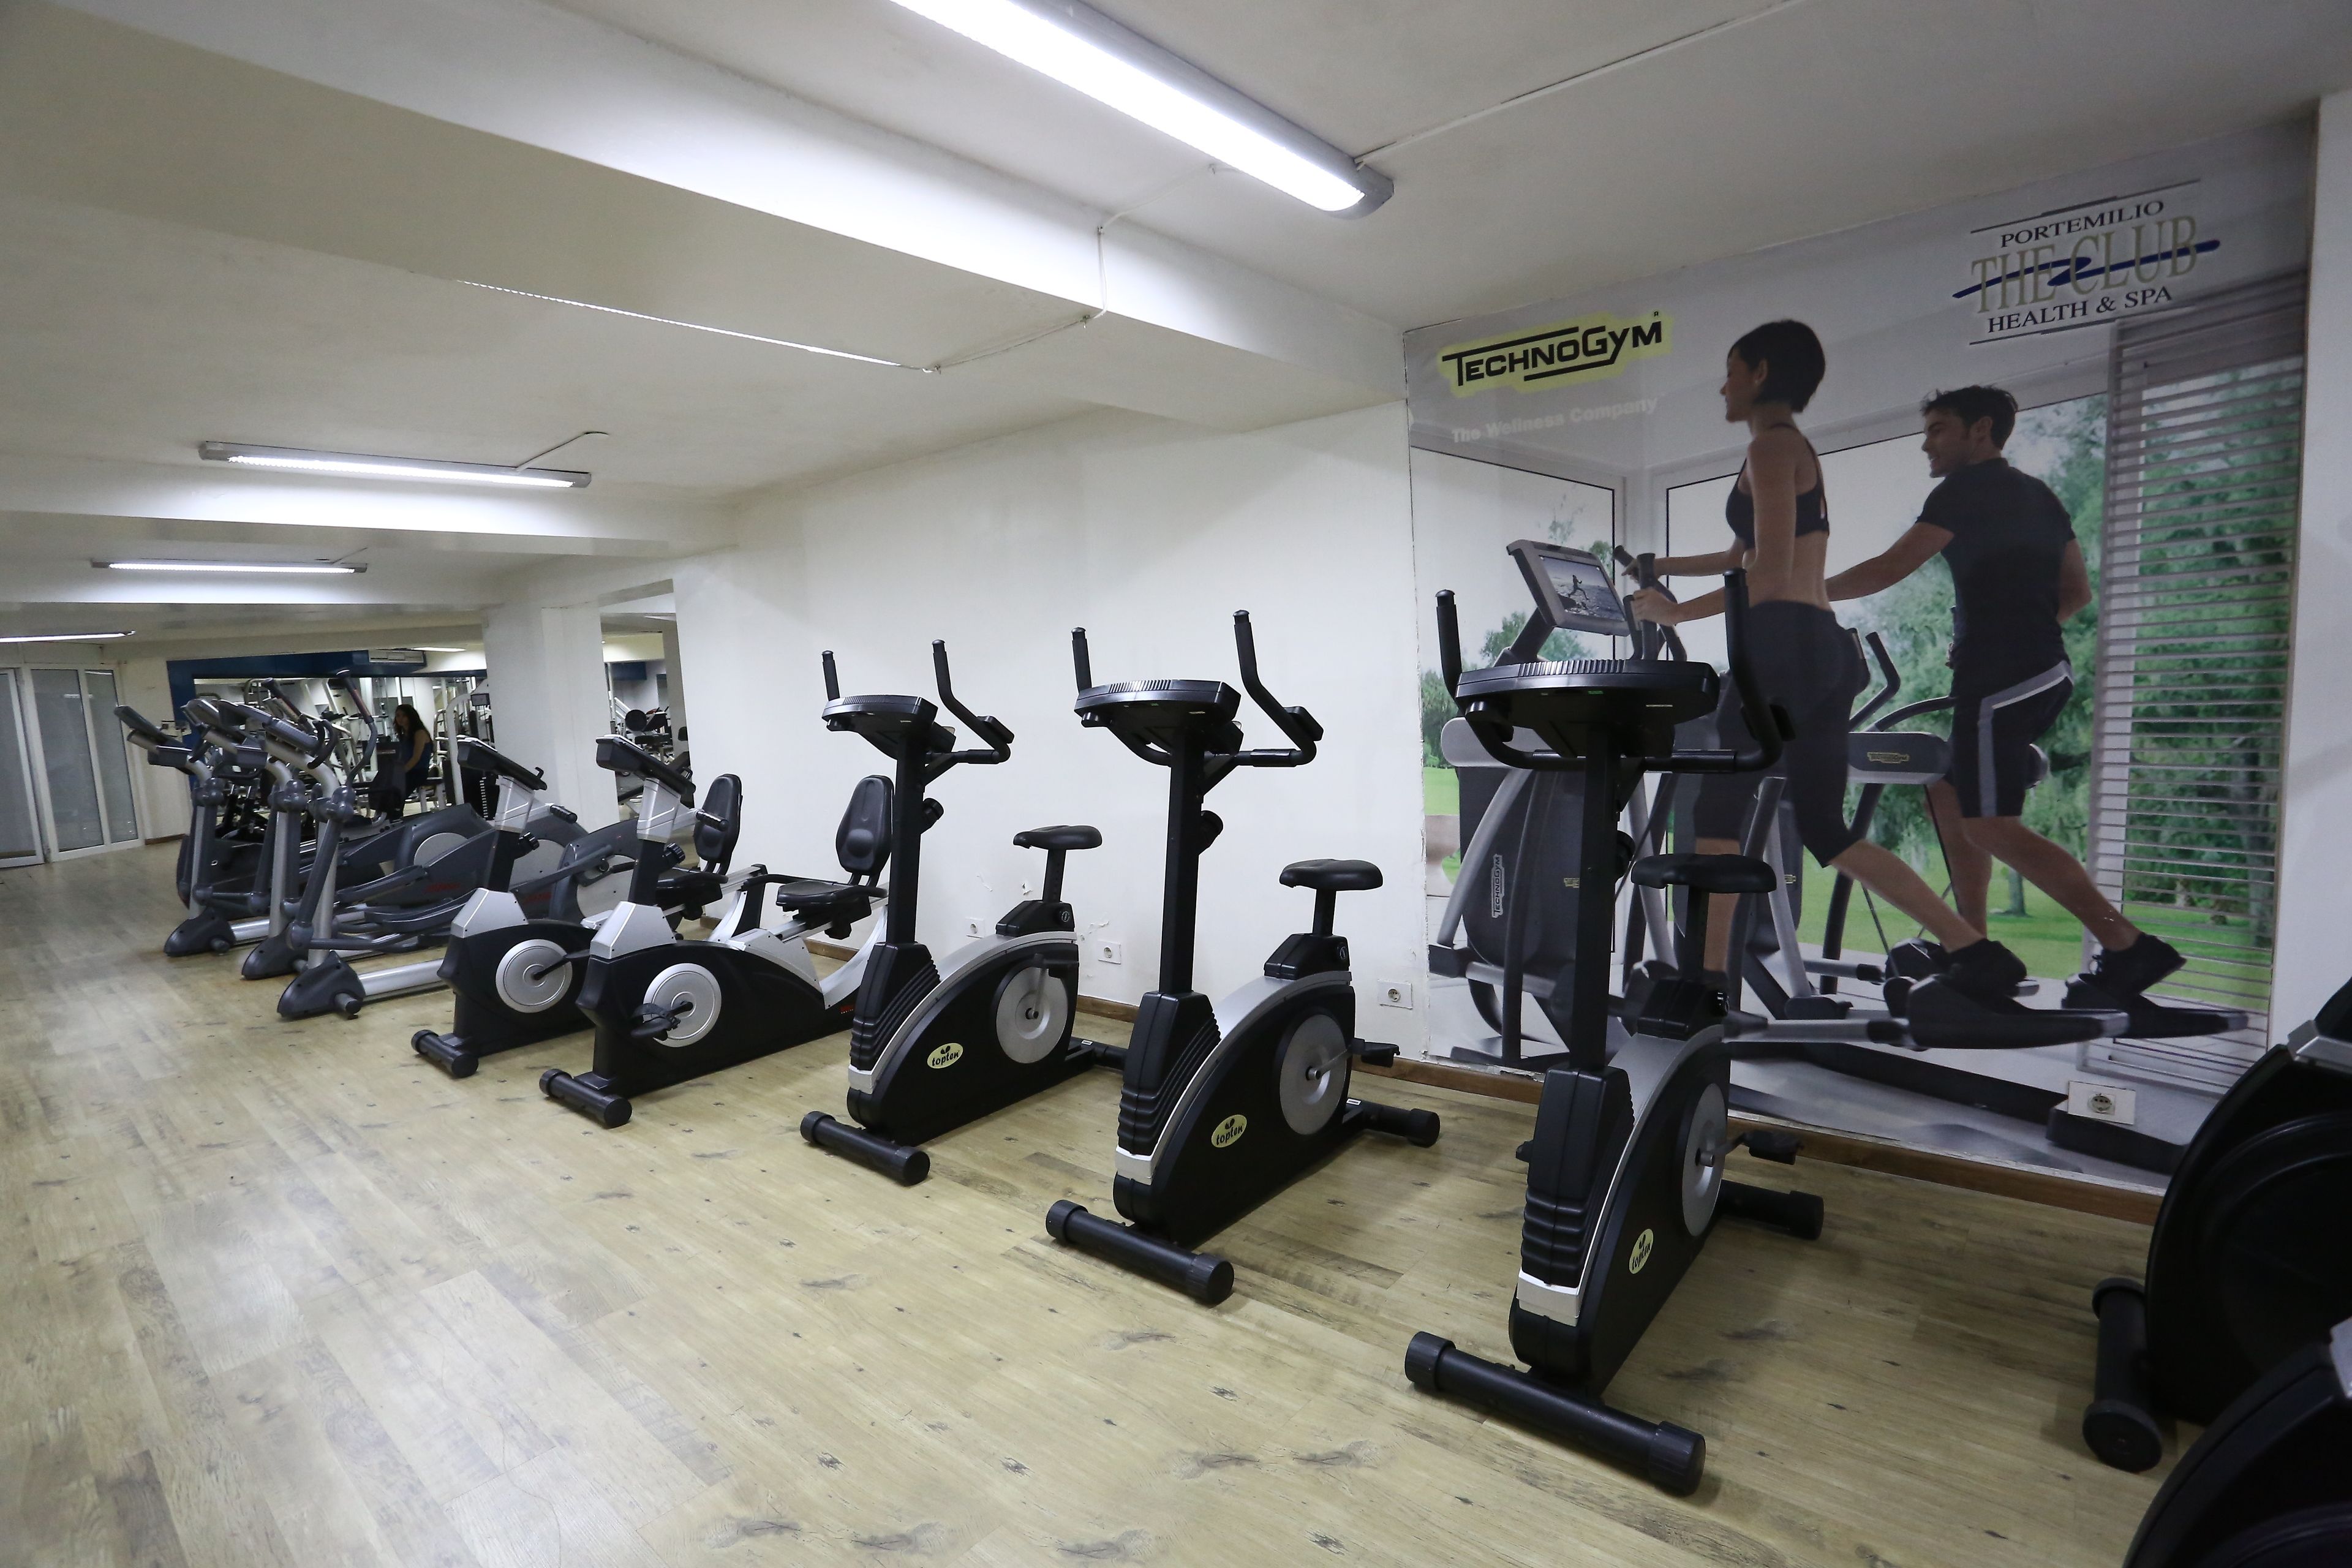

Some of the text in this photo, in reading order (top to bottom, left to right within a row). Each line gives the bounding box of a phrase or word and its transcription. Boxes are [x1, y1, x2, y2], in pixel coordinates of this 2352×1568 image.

[2001, 200, 2164, 248] PORTEMILIO
[1971, 216, 2198, 314] THE CLUB
[1988, 286, 2173, 333] HEALTH & SPA
[1451, 398, 1657, 443] The Wellness Company
[932, 1052, 959, 1066] topten
[1216, 1125, 1243, 1145] topten
